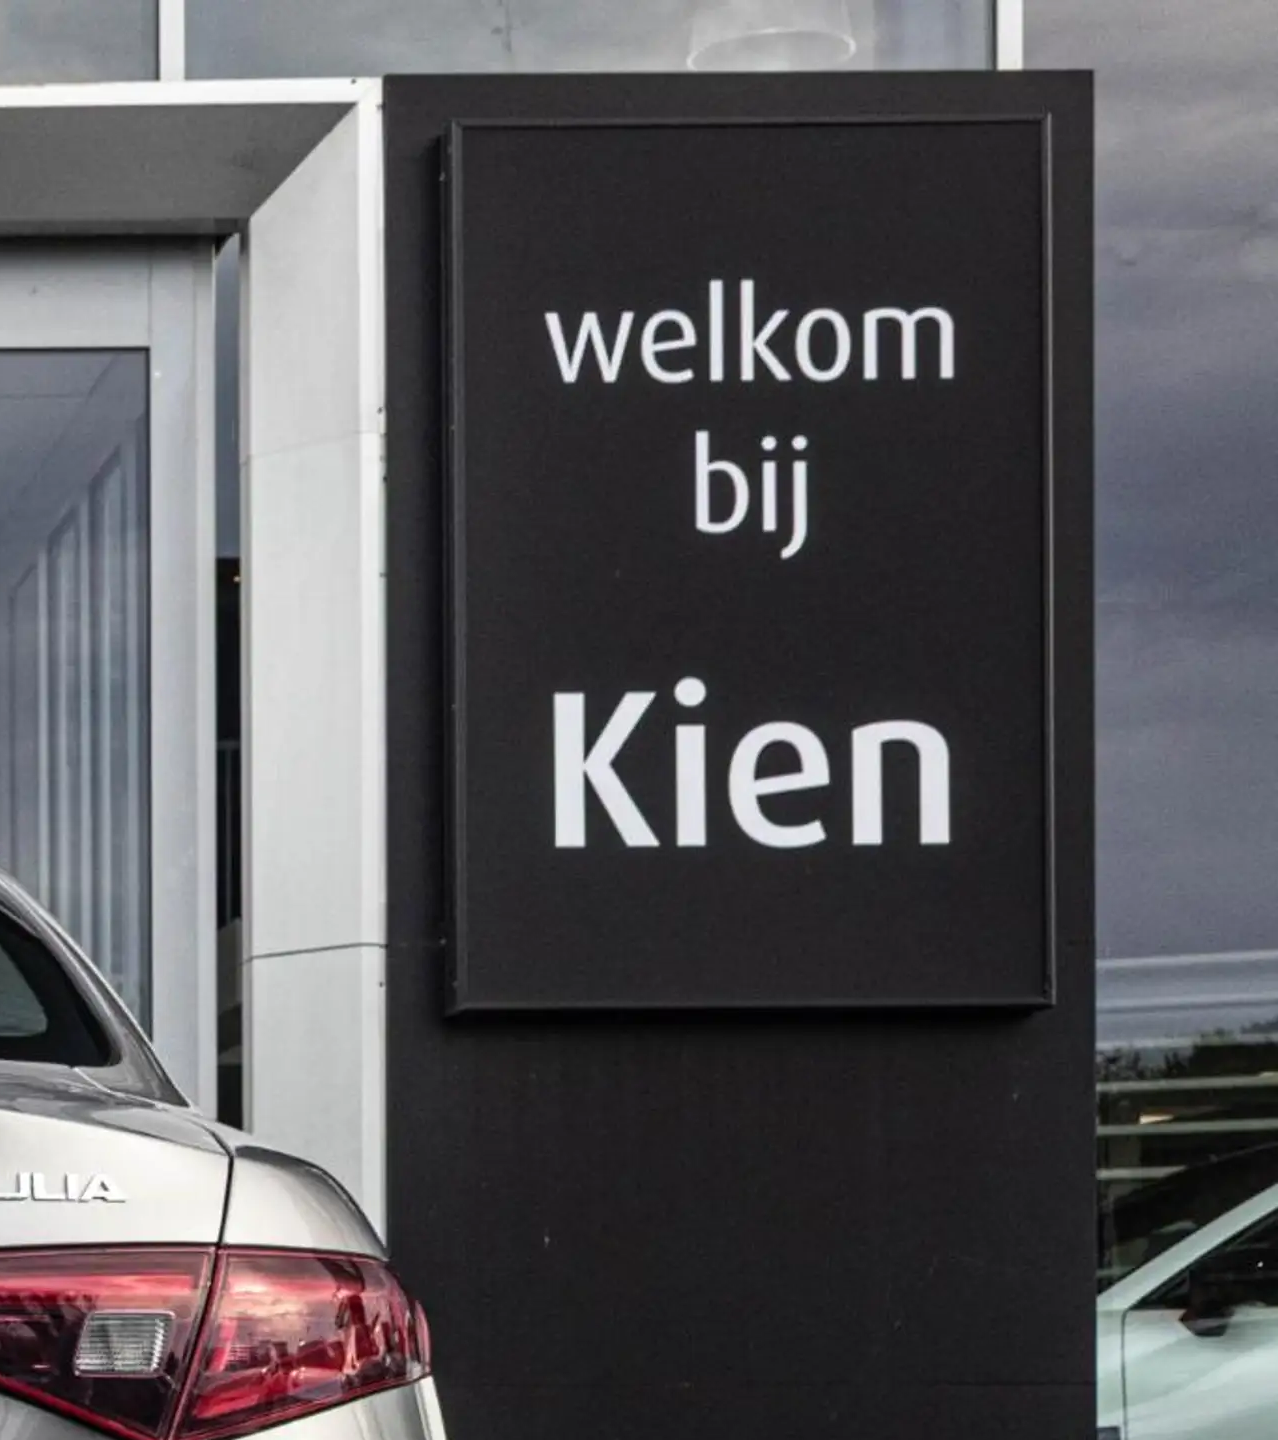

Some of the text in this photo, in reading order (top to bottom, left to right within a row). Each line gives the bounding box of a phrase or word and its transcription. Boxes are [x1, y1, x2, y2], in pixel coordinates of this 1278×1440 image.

[543, 279, 956, 384] welkom
[694, 429, 809, 560] bij
[553, 676, 951, 849] Kien
